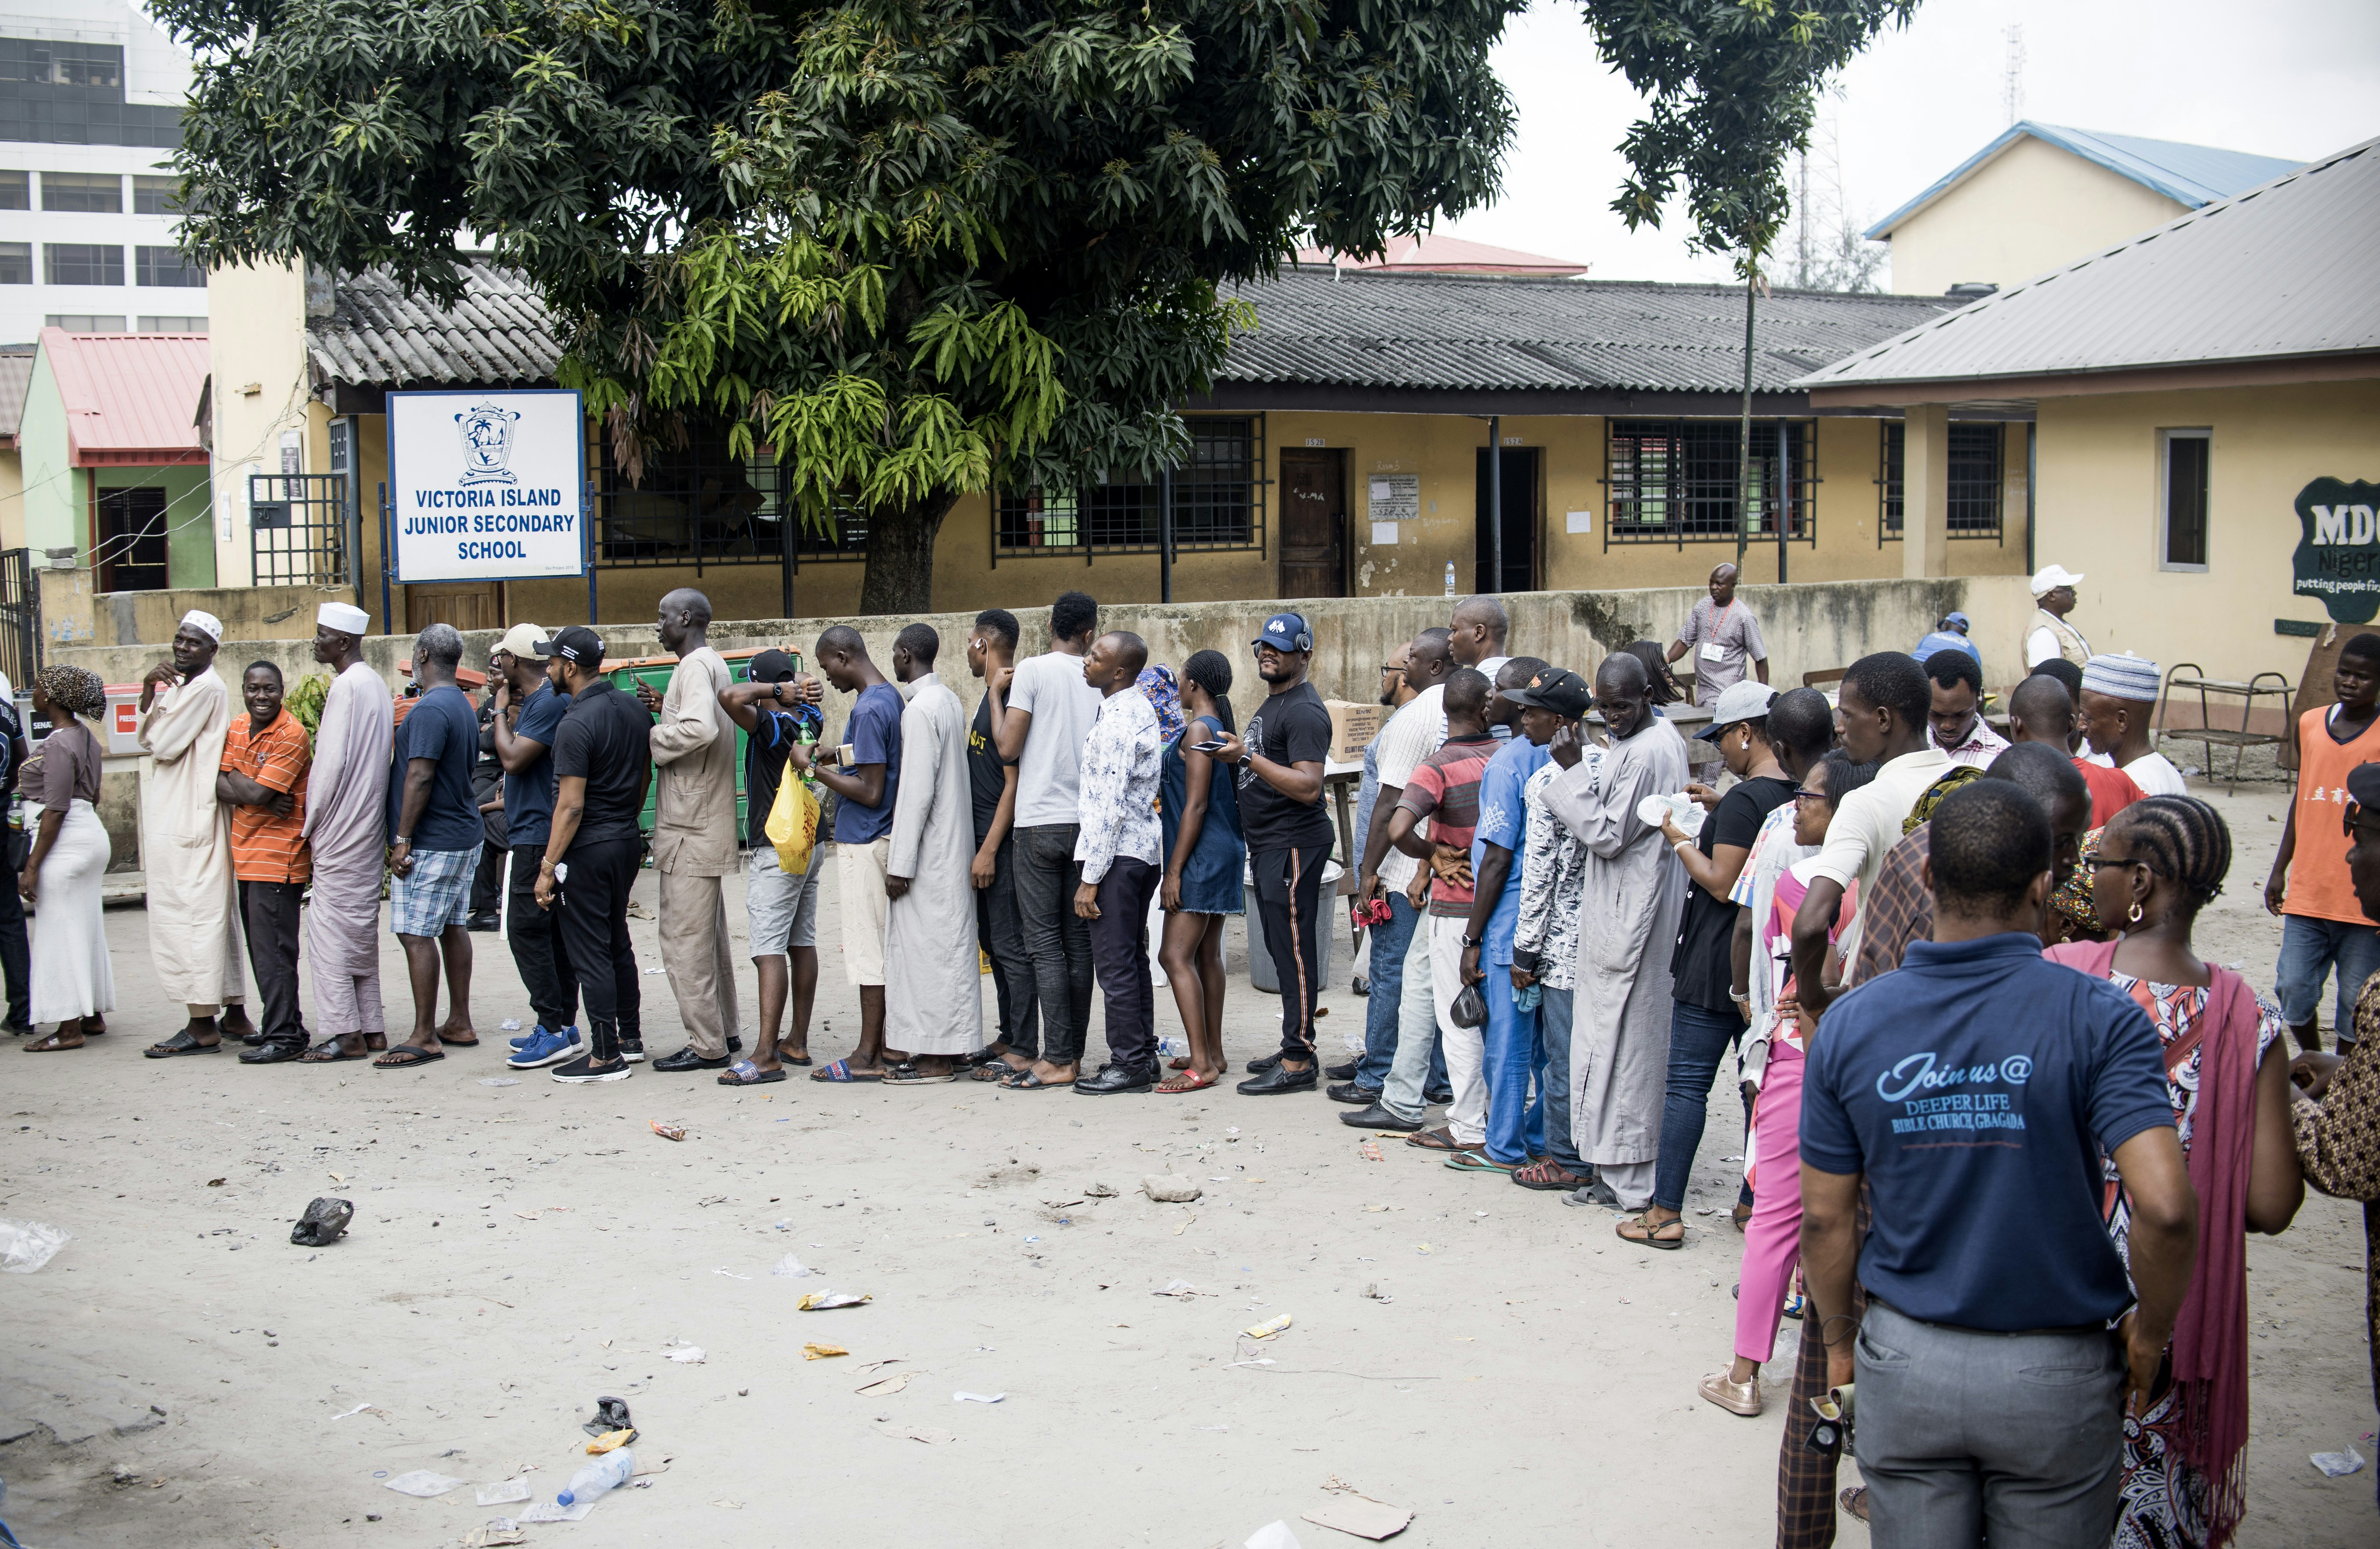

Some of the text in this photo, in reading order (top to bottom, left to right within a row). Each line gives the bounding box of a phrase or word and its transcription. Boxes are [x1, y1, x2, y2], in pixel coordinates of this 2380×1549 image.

[464, 441, 473, 463] VICTORIA
[416, 489, 560, 508] VICTORIA ISLAND
[405, 515, 574, 535] JUNIOR SECONDARY
[2311, 505, 2380, 545] MD
[459, 541, 526, 559] SCHOOL
[2319, 549, 2380, 578] Niger
[2296, 579, 2335, 593] putting
[2336, 580, 2366, 594] people
[33, 721, 53, 729] SENA
[1876, 1052, 2033, 1102] Join us @
[1905, 1094, 2010, 1116] DEEPER LIFE
[1891, 1117, 1926, 1134] BIBLE
[1975, 1112, 2026, 1130] GBAGADA
